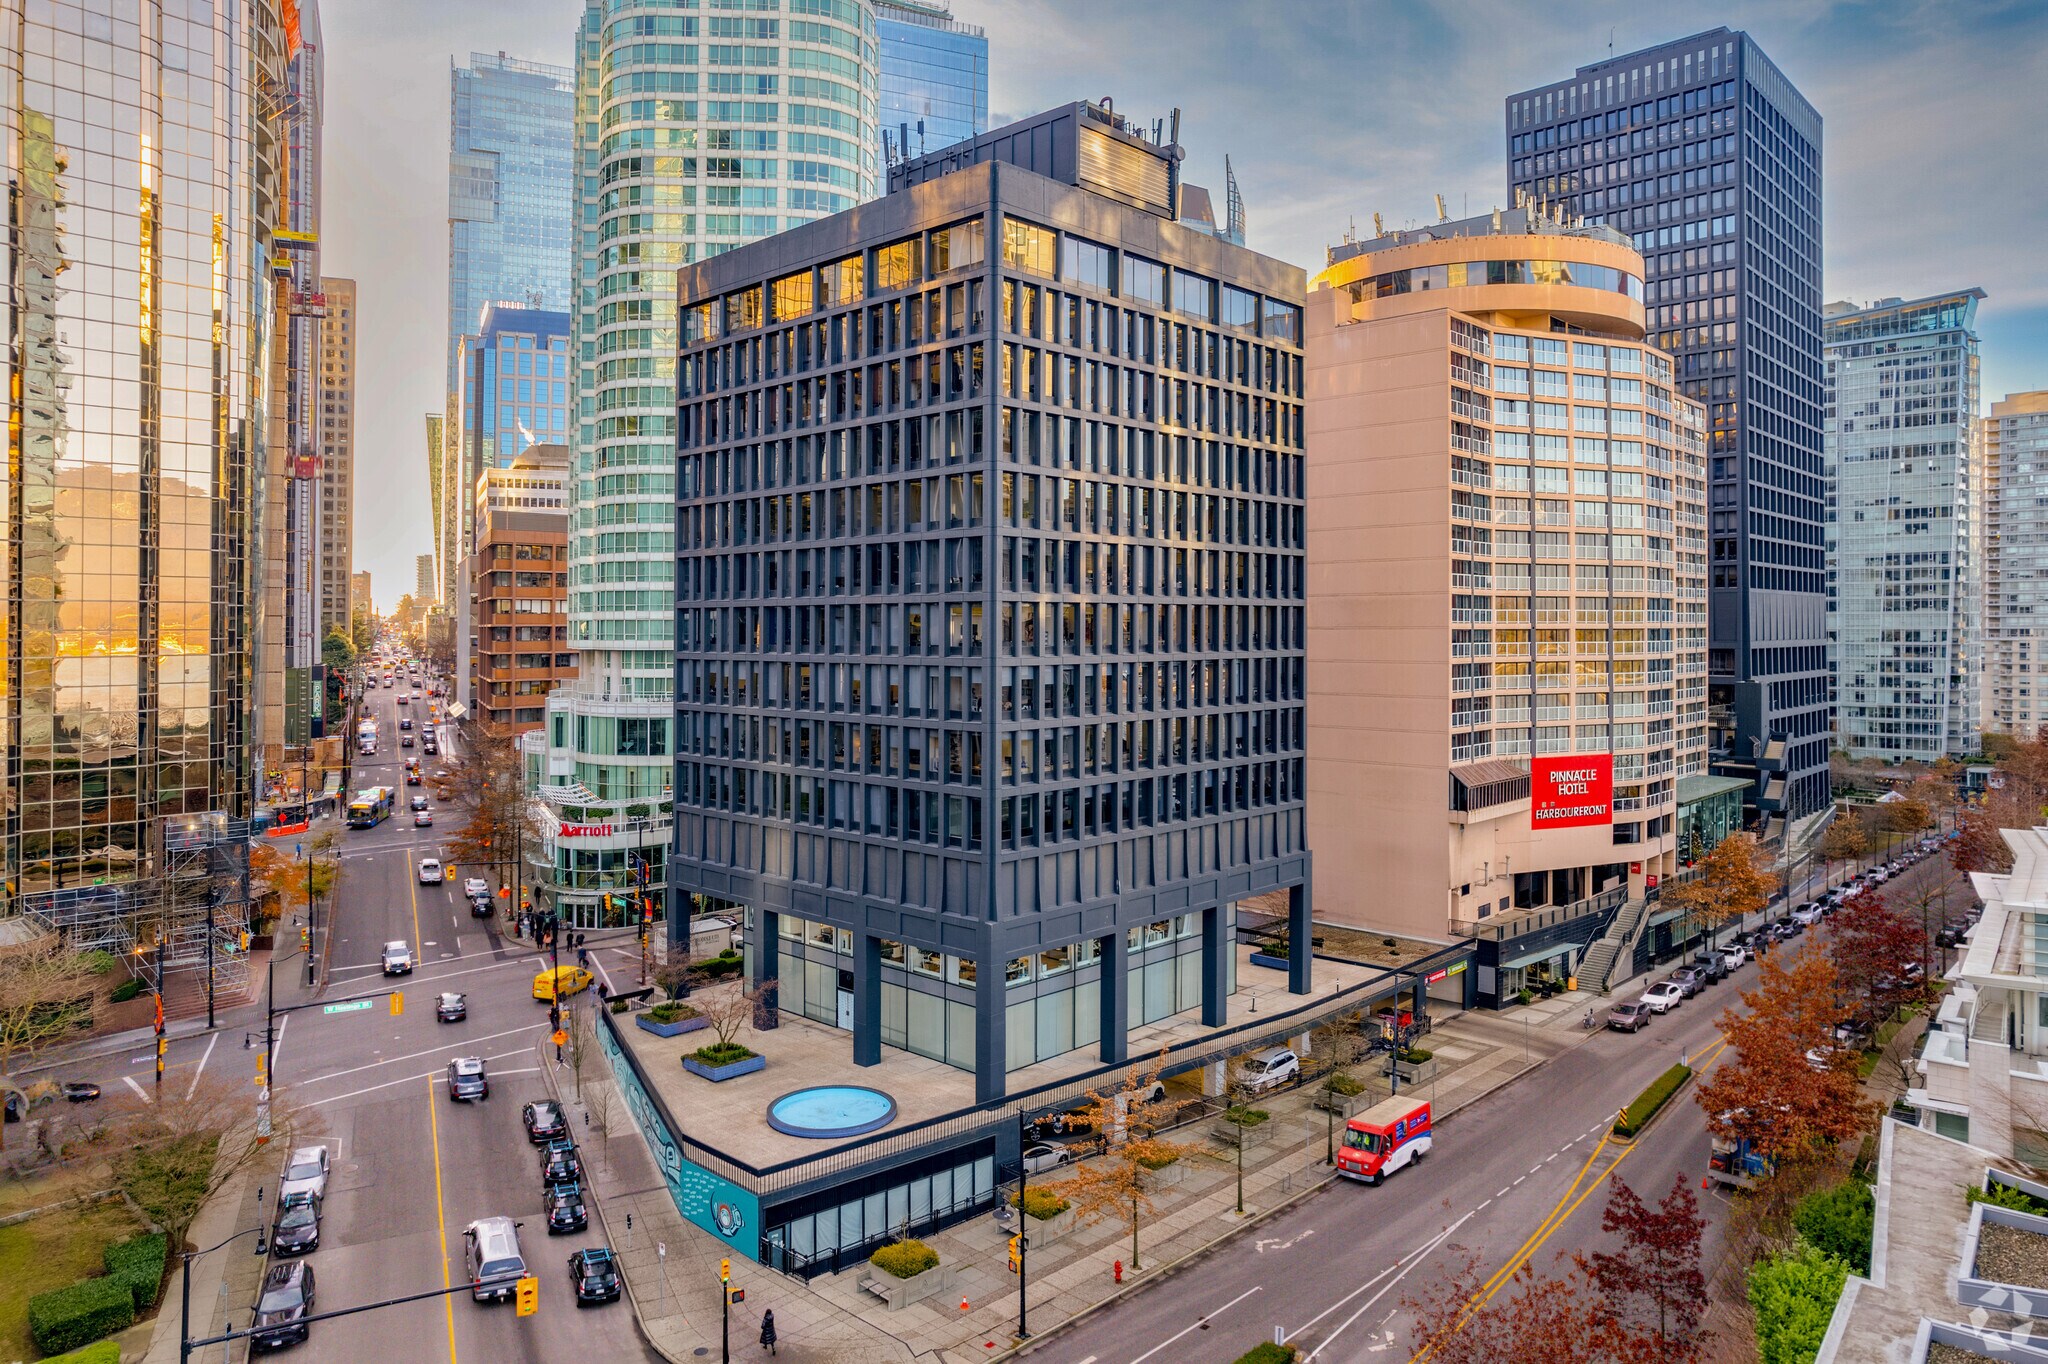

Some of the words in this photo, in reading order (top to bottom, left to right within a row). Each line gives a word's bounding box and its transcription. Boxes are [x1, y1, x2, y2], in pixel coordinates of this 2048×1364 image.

[1549, 769, 1597, 783] PINNACLE
[1558, 782, 1589, 796] HOTEL
[1535, 804, 1607, 820] HARBOURFRONT
[558, 823, 612, 837] Marriott
